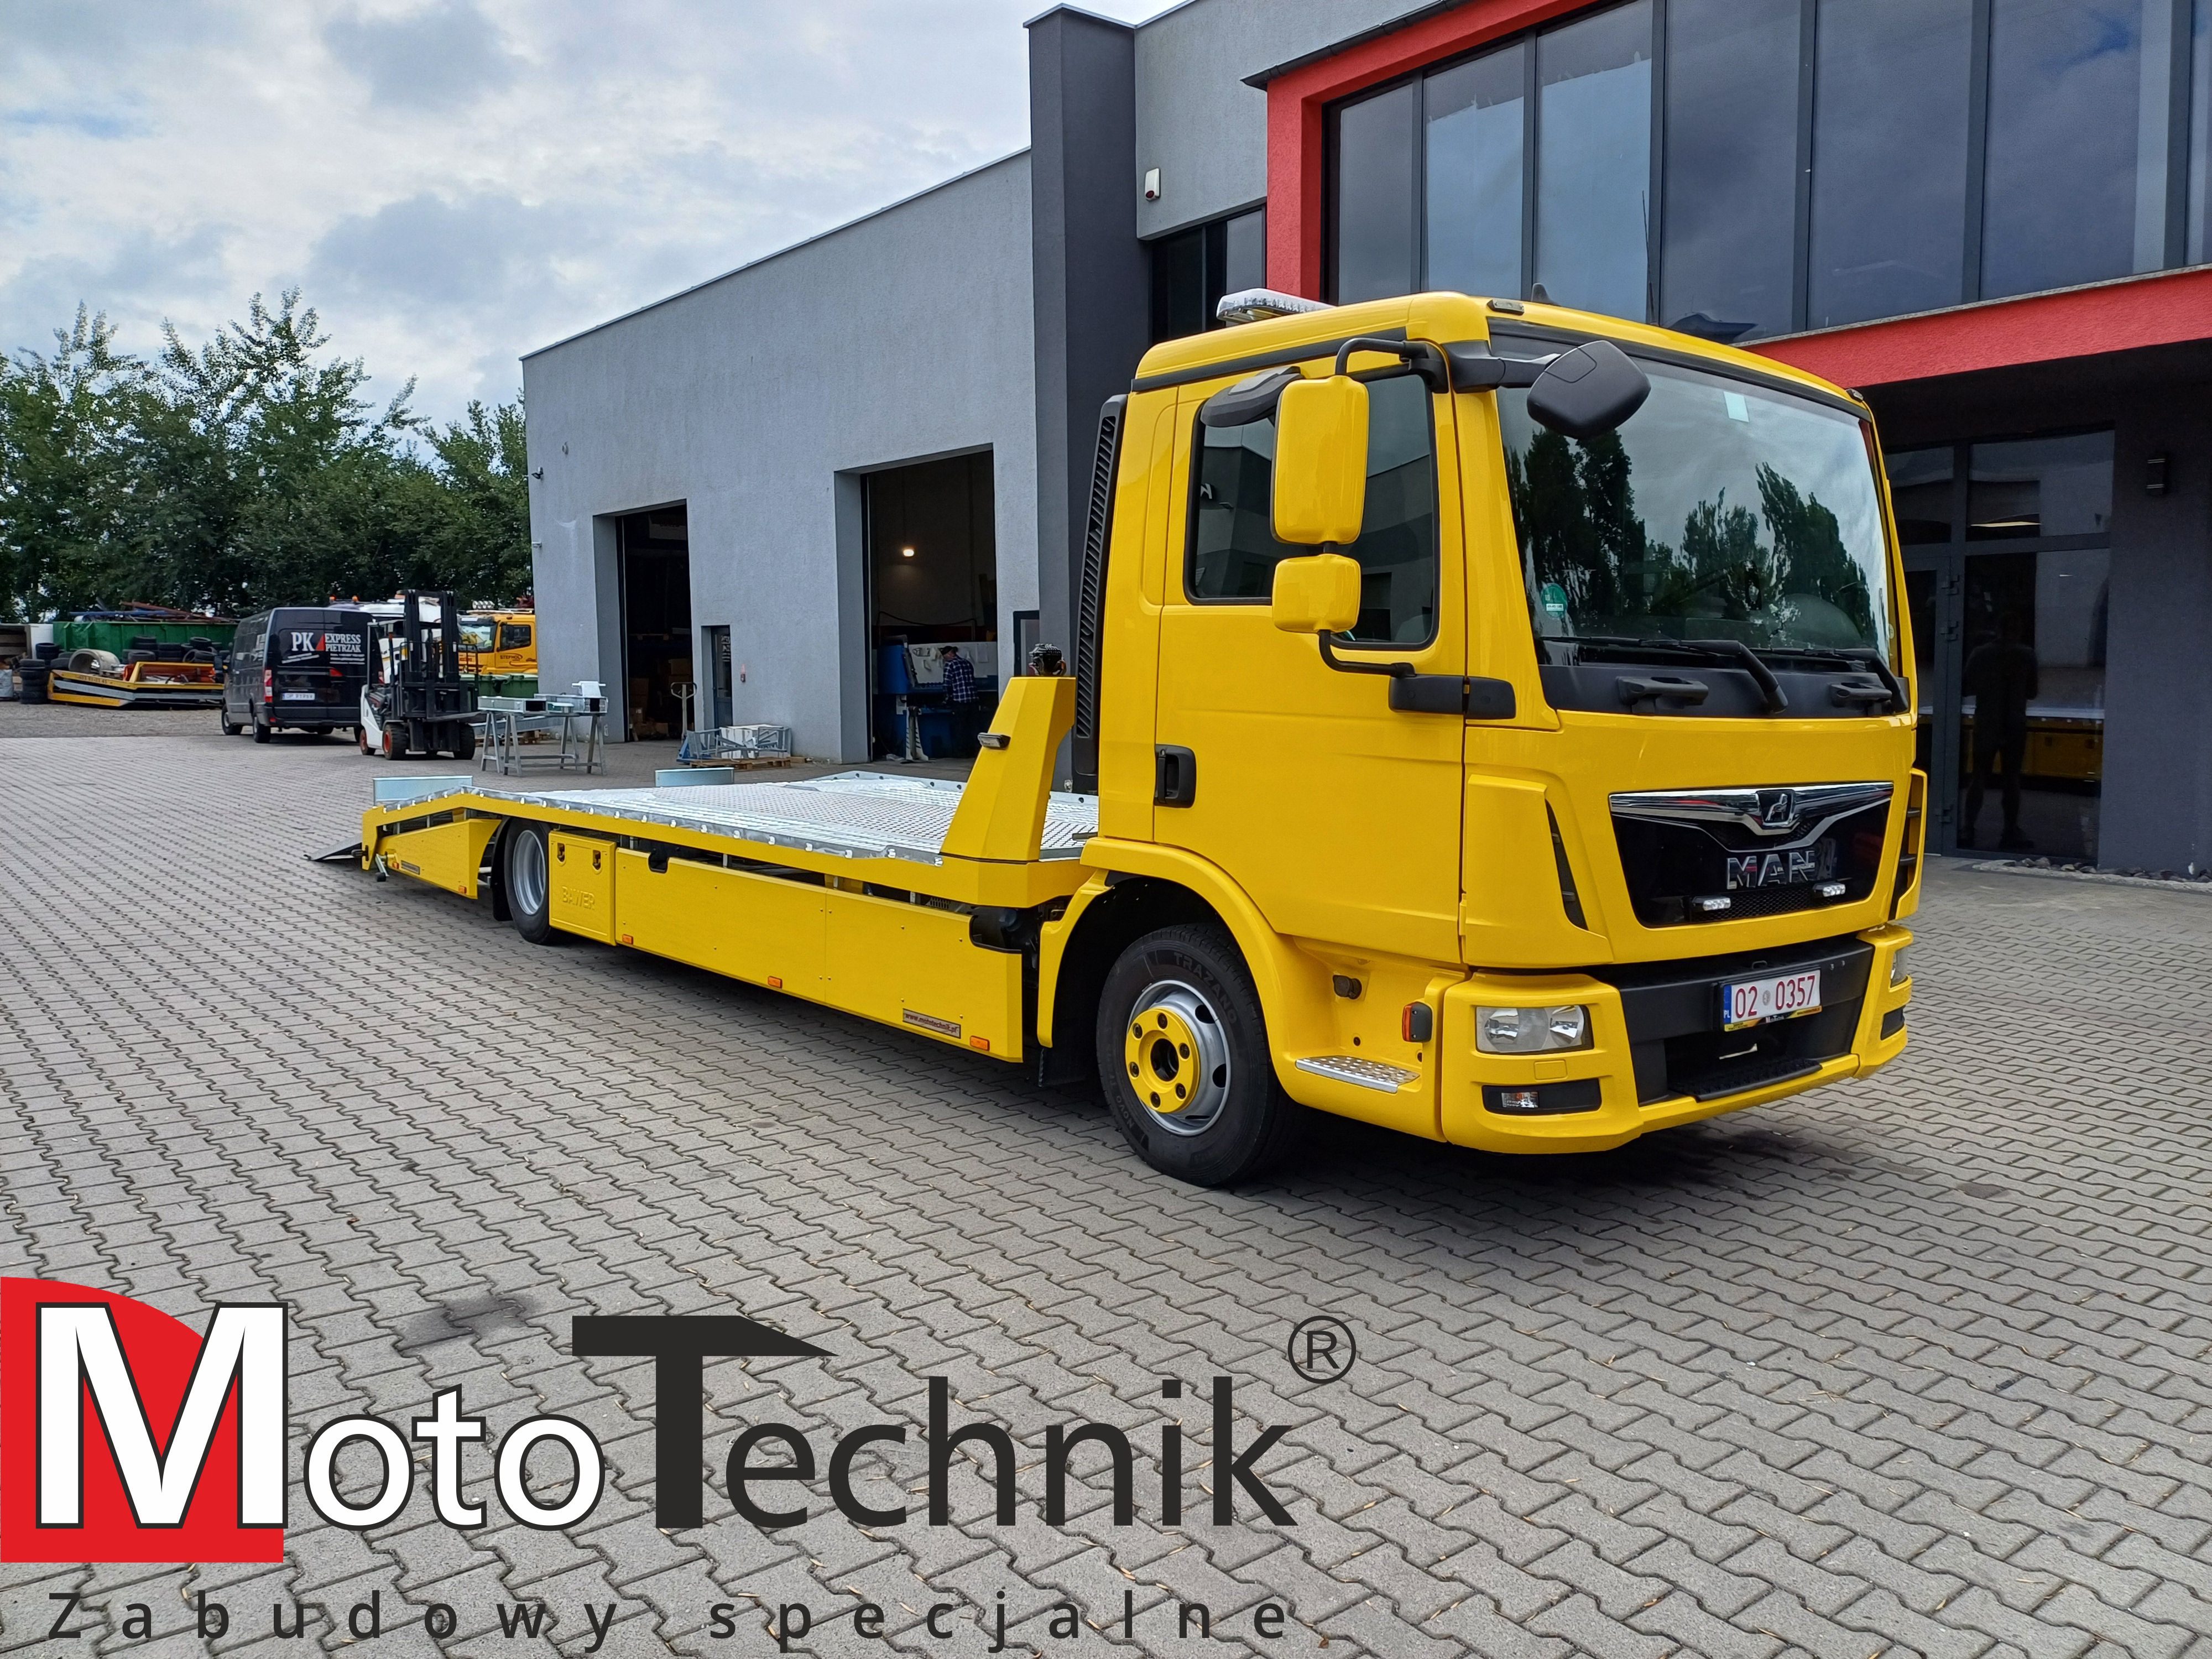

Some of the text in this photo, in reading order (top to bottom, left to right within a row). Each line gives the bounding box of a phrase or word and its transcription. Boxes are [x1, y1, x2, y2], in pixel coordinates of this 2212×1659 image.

[291, 632, 315, 651] PK
[325, 633, 361, 644] EXPRESS
[325, 644, 362, 653] PIETRZAK
[1726, 850, 1815, 890] MAN
[562, 886, 595, 911] BAWER
[1173, 952, 1238, 1023] TRAZANO
[1735, 975, 1815, 1019] 02 0357
[1724, 1010, 1730, 1019] PL
